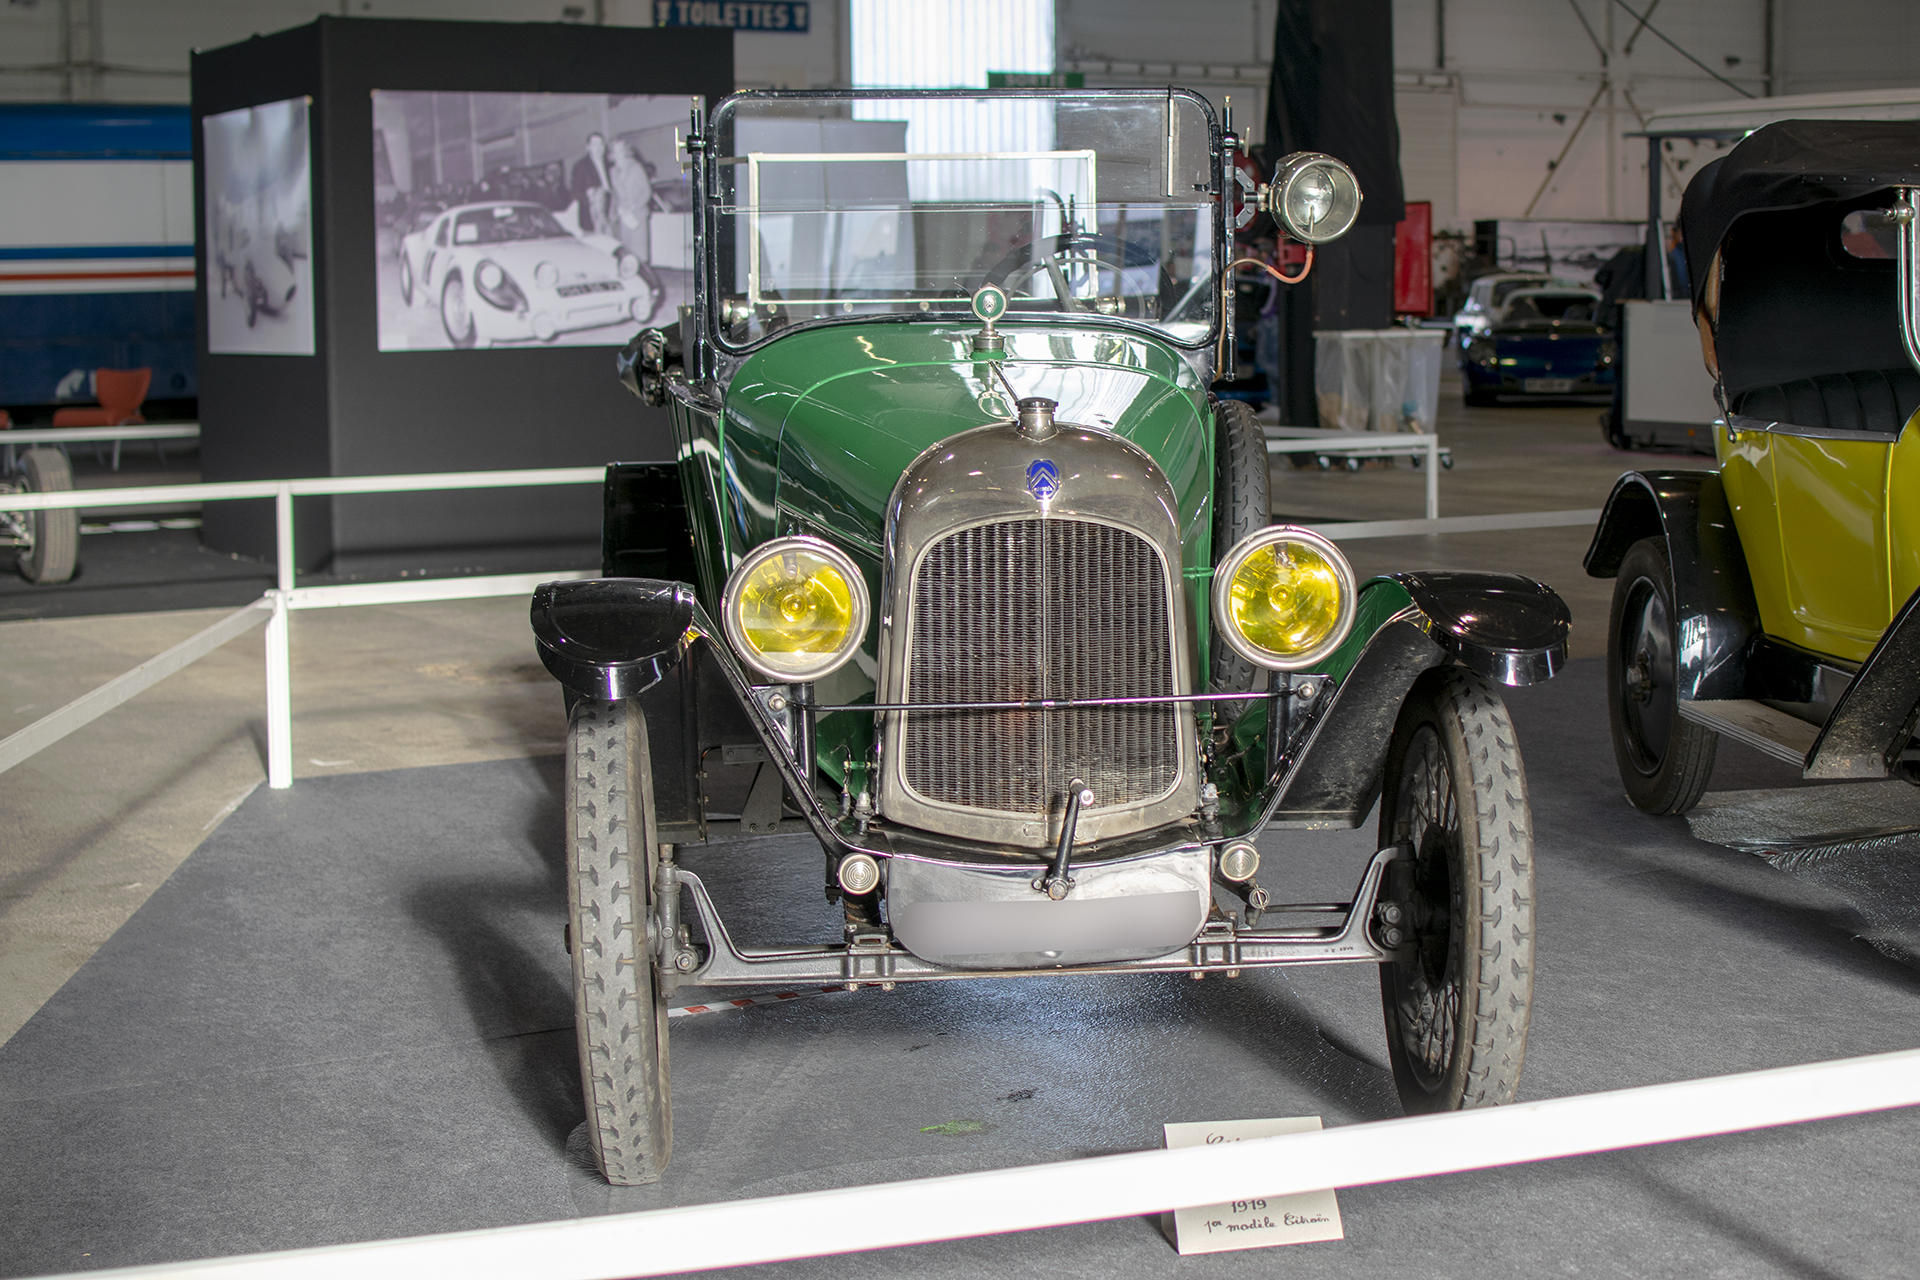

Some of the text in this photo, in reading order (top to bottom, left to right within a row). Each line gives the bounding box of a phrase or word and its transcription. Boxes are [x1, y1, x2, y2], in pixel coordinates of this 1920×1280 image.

[676, 1, 789, 28] TOILETTES
[1230, 1198, 1267, 1214] 1919
[1225, 1216, 1277, 1232] modèle
[1283, 1212, 1330, 1226] Citroën
